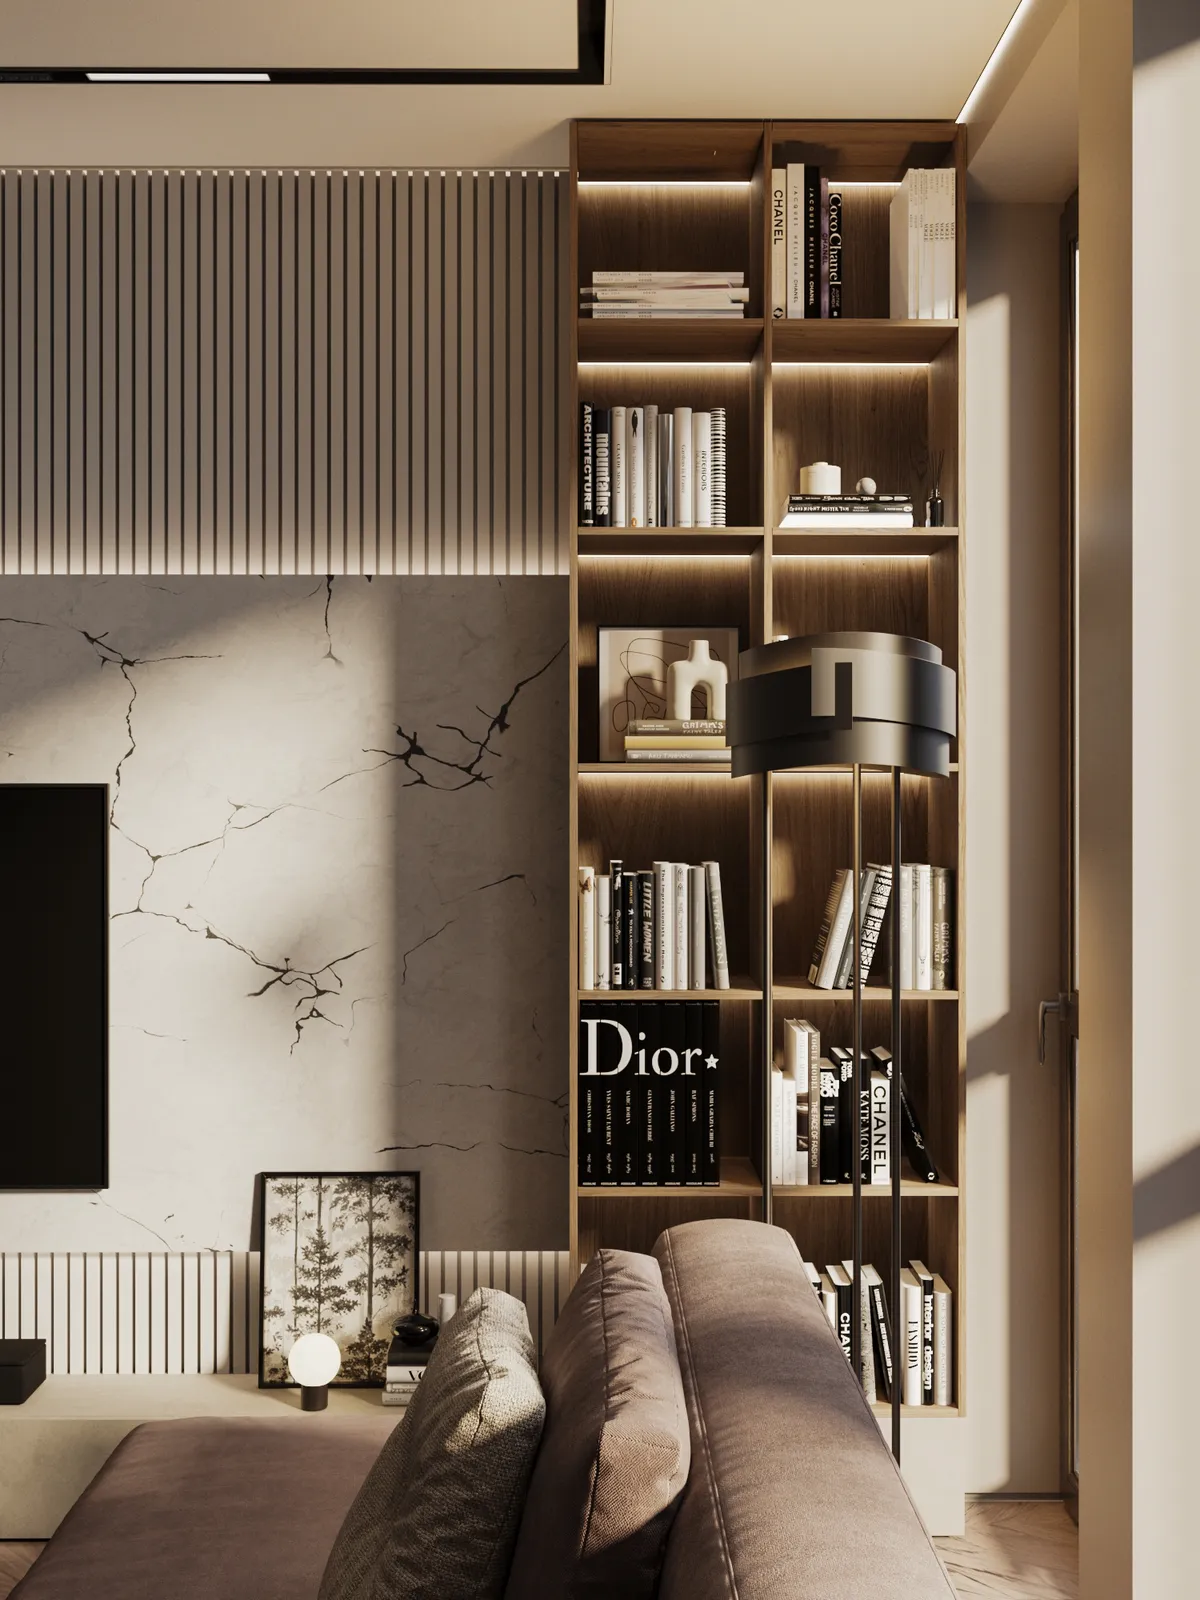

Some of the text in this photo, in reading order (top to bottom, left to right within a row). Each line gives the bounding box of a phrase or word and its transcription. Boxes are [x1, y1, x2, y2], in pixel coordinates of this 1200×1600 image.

[773, 189, 784, 246] CHANEL
[829, 194, 842, 285] Coco Chanel
[583, 405, 592, 510] ARCHITECTURE
[596, 433, 610, 515] mountains
[682, 721, 724, 729] GRIMM'S
[643, 882, 652, 963] LITTLE WOMEN
[716, 936, 725, 964] PAN
[940, 922, 950, 964] GRIMM'S
[579, 1019, 702, 1076] Dior
[810, 1034, 818, 1090] VOGUE MODEL
[811, 1130, 818, 1140] OF
[860, 1090, 869, 1160] KATE MOSS
[874, 1086, 886, 1174] CHANEL
[840, 1312, 850, 1362] CHAN
[908, 1321, 918, 1368] FASHION
[923, 1346, 934, 1390] design
